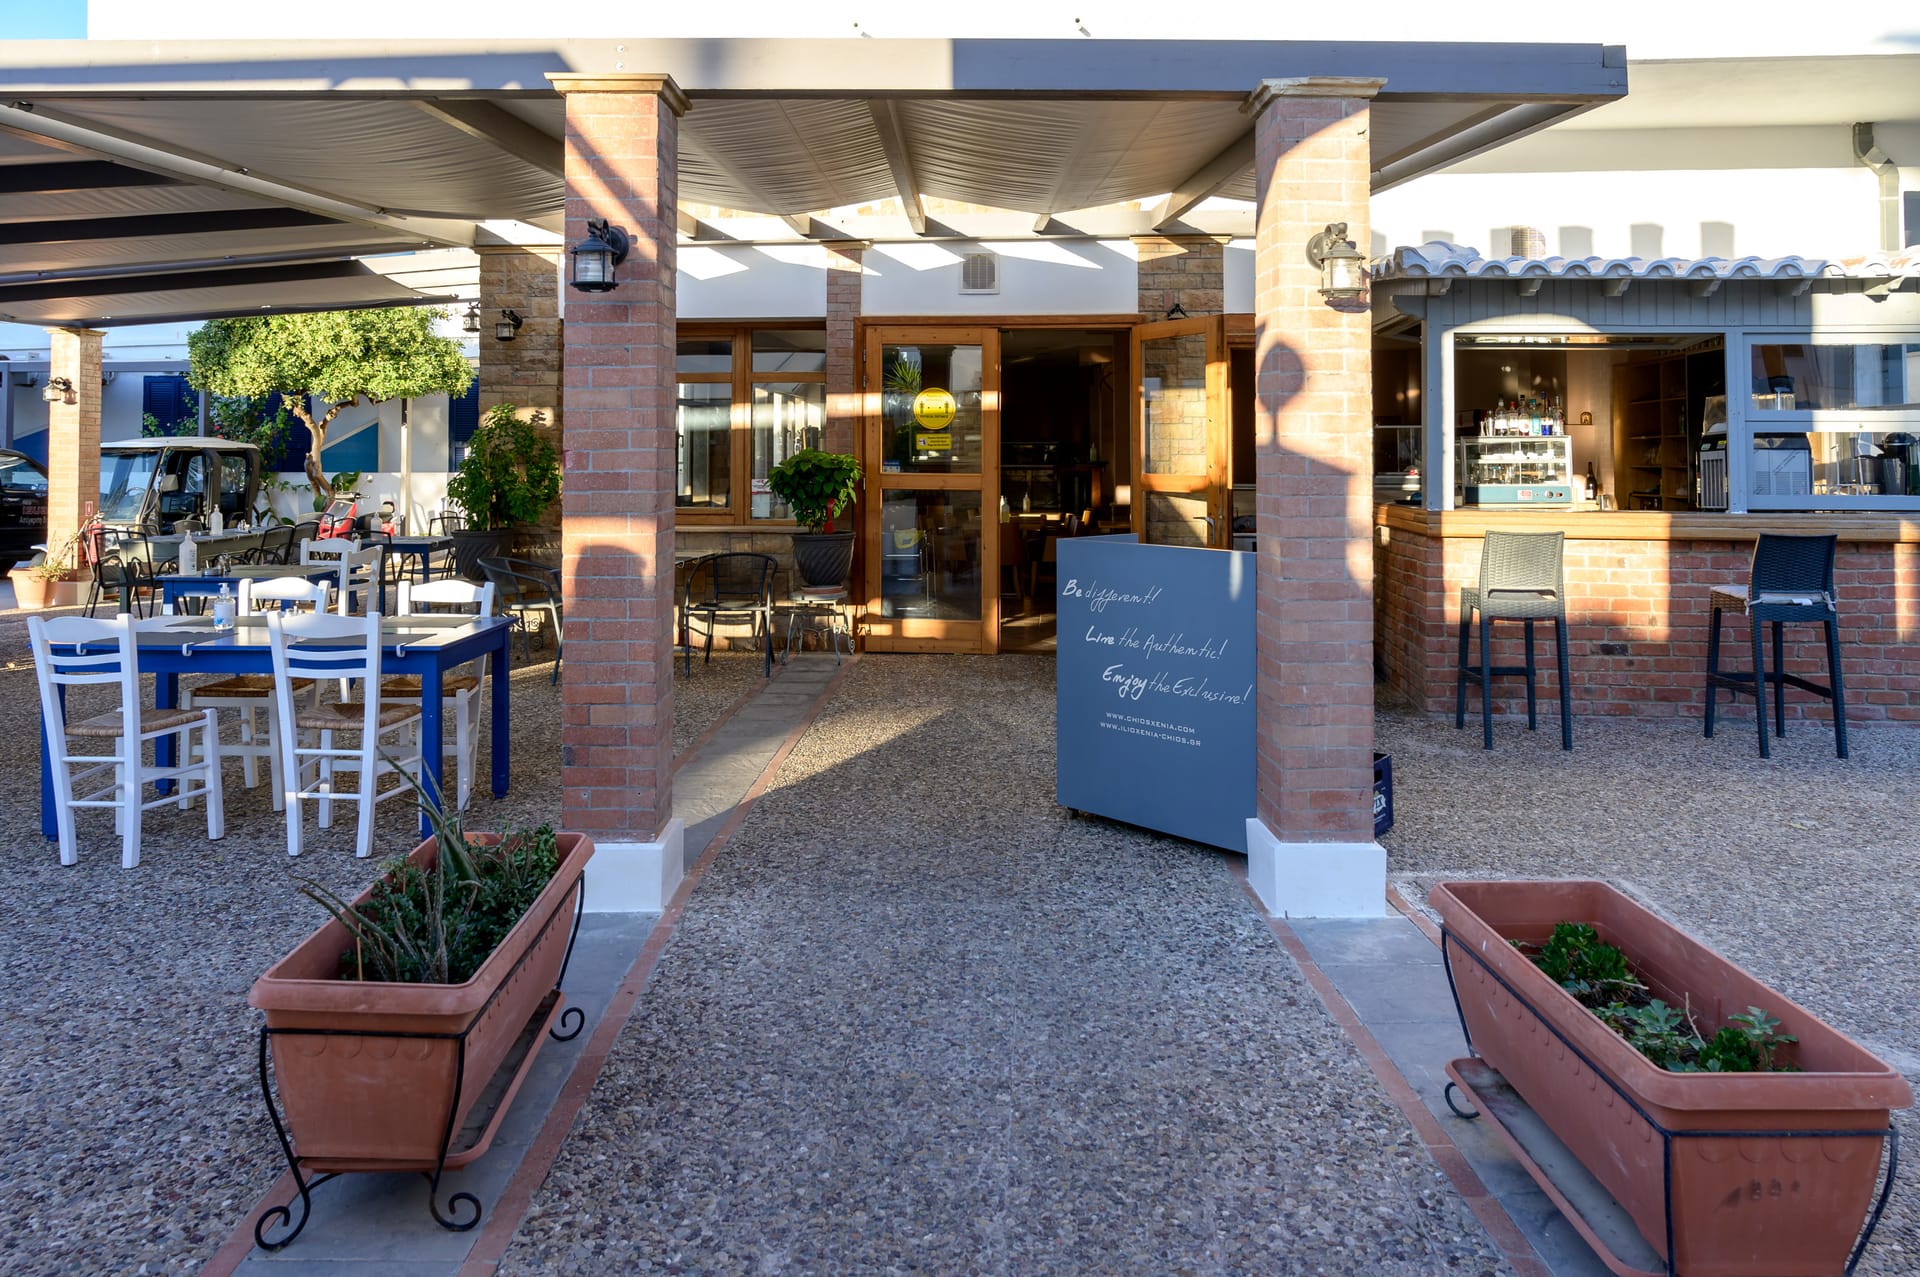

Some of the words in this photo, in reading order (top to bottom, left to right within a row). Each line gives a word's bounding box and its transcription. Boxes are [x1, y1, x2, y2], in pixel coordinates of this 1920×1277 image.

[1062, 579, 1082, 598] Be
[1085, 580, 1163, 613] different!
[1118, 627, 1139, 648] the
[1142, 632, 1228, 660] Authentic!
[1102, 664, 1149, 700] Enjoy
[1148, 671, 1170, 693] the
[1172, 676, 1253, 705] Exclusive!
